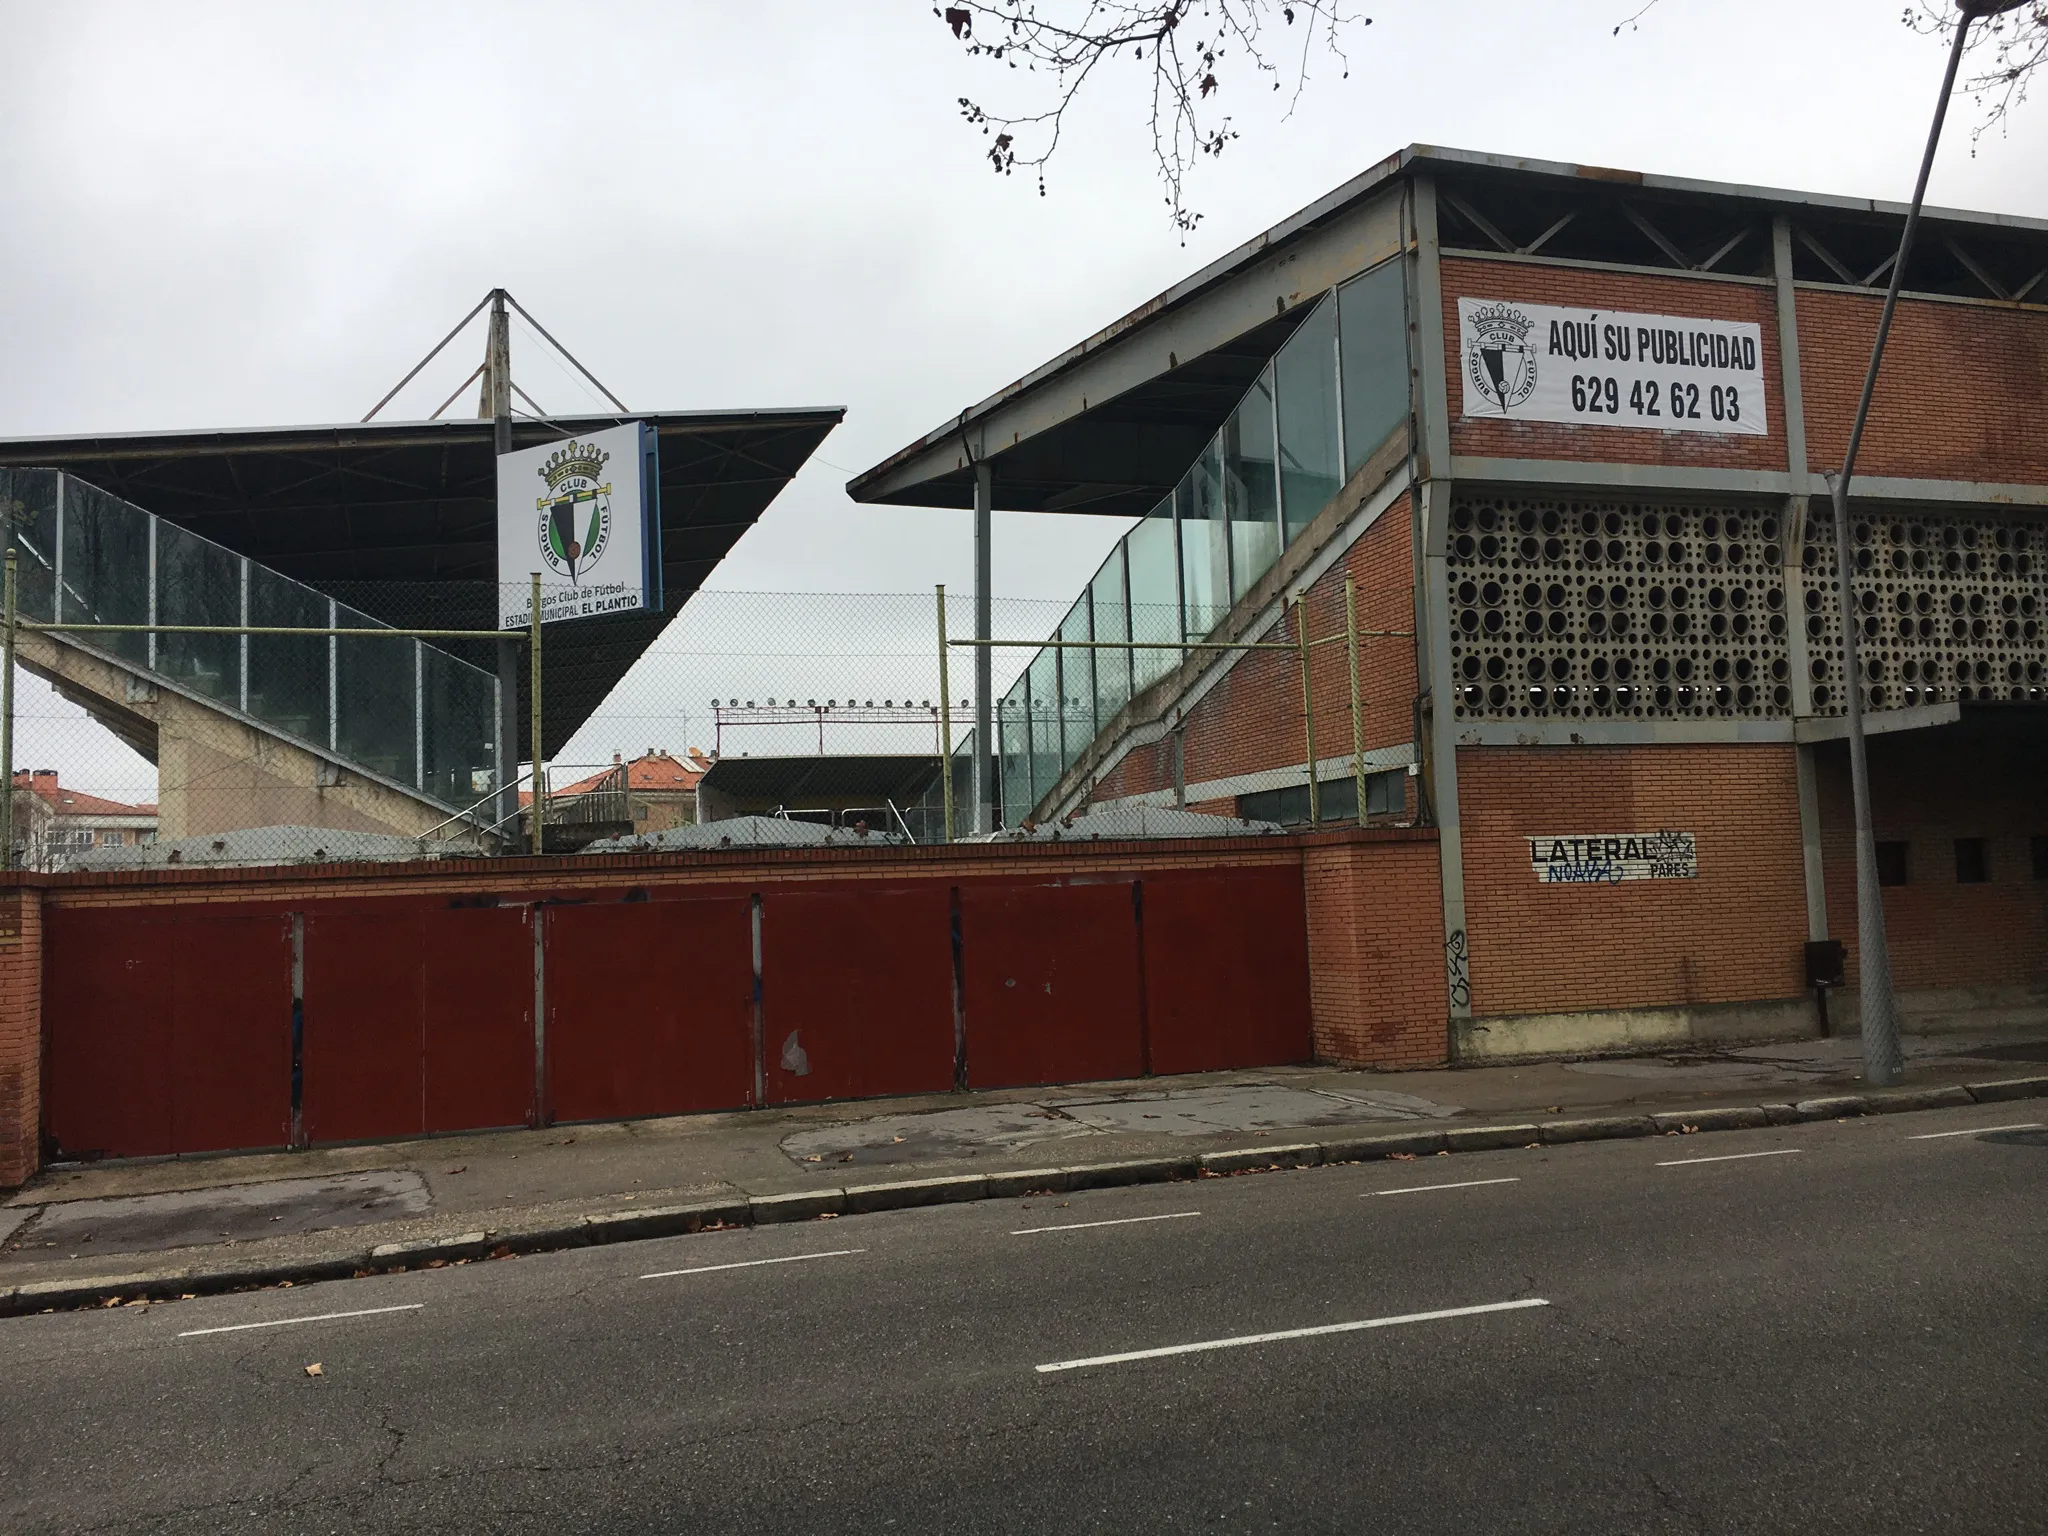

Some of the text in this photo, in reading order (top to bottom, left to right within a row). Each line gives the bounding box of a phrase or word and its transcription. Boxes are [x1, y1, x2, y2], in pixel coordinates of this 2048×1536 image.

[1489, 332, 1515, 343] CLUB
[1549, 314, 1757, 371] AQUÍ SU PUBLICIDAD
[1471, 351, 1491, 396] BURGOS
[1571, 374, 1740, 423] 629 42 62 03
[560, 478, 588, 493] CLUB
[540, 513, 560, 567] BURGOS
[526, 581, 625, 609] Bgos Club de Fútbol
[505, 612, 537, 628] ESTADI
[581, 601, 593, 615] EL
[595, 594, 638, 613] PLANTIO
[1531, 836, 1658, 863] LATERAL
[1650, 862, 1690, 879] PARES
